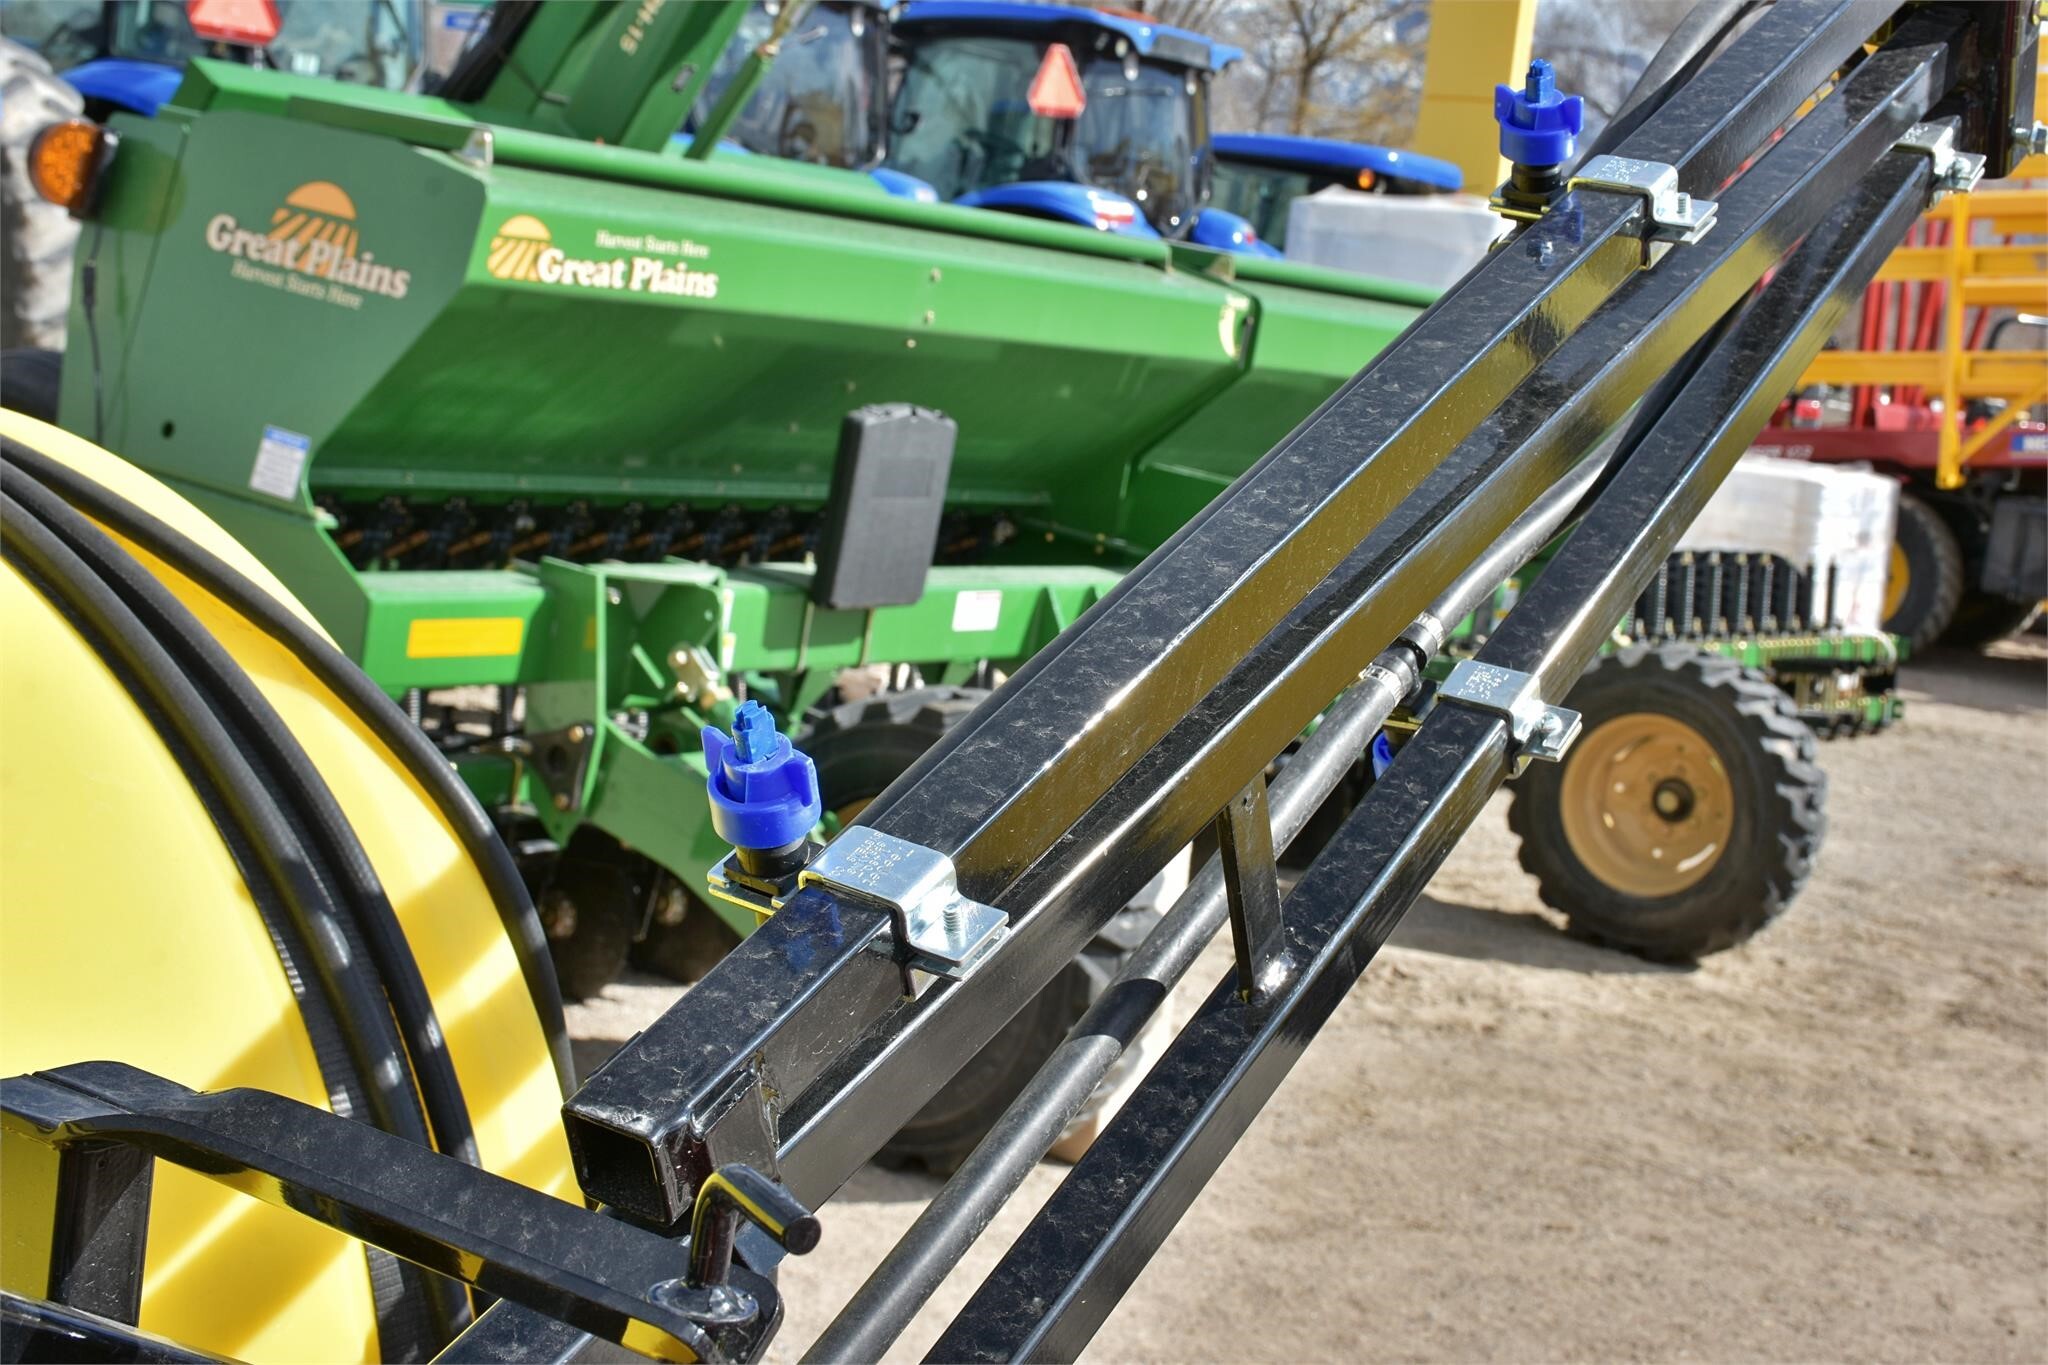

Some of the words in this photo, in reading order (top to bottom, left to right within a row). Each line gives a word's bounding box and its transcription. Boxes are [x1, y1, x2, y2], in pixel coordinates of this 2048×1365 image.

[206, 213, 305, 270] Great
[304, 238, 411, 299] Plains
[595, 229, 643, 251] Harvest
[645, 234, 681, 255] Starts
[682, 238, 711, 260] Here
[231, 258, 286, 290] Harvest
[286, 273, 326, 300] Starts
[327, 284, 365, 311] Here
[537, 247, 628, 290] Great
[629, 255, 719, 299] Plains
